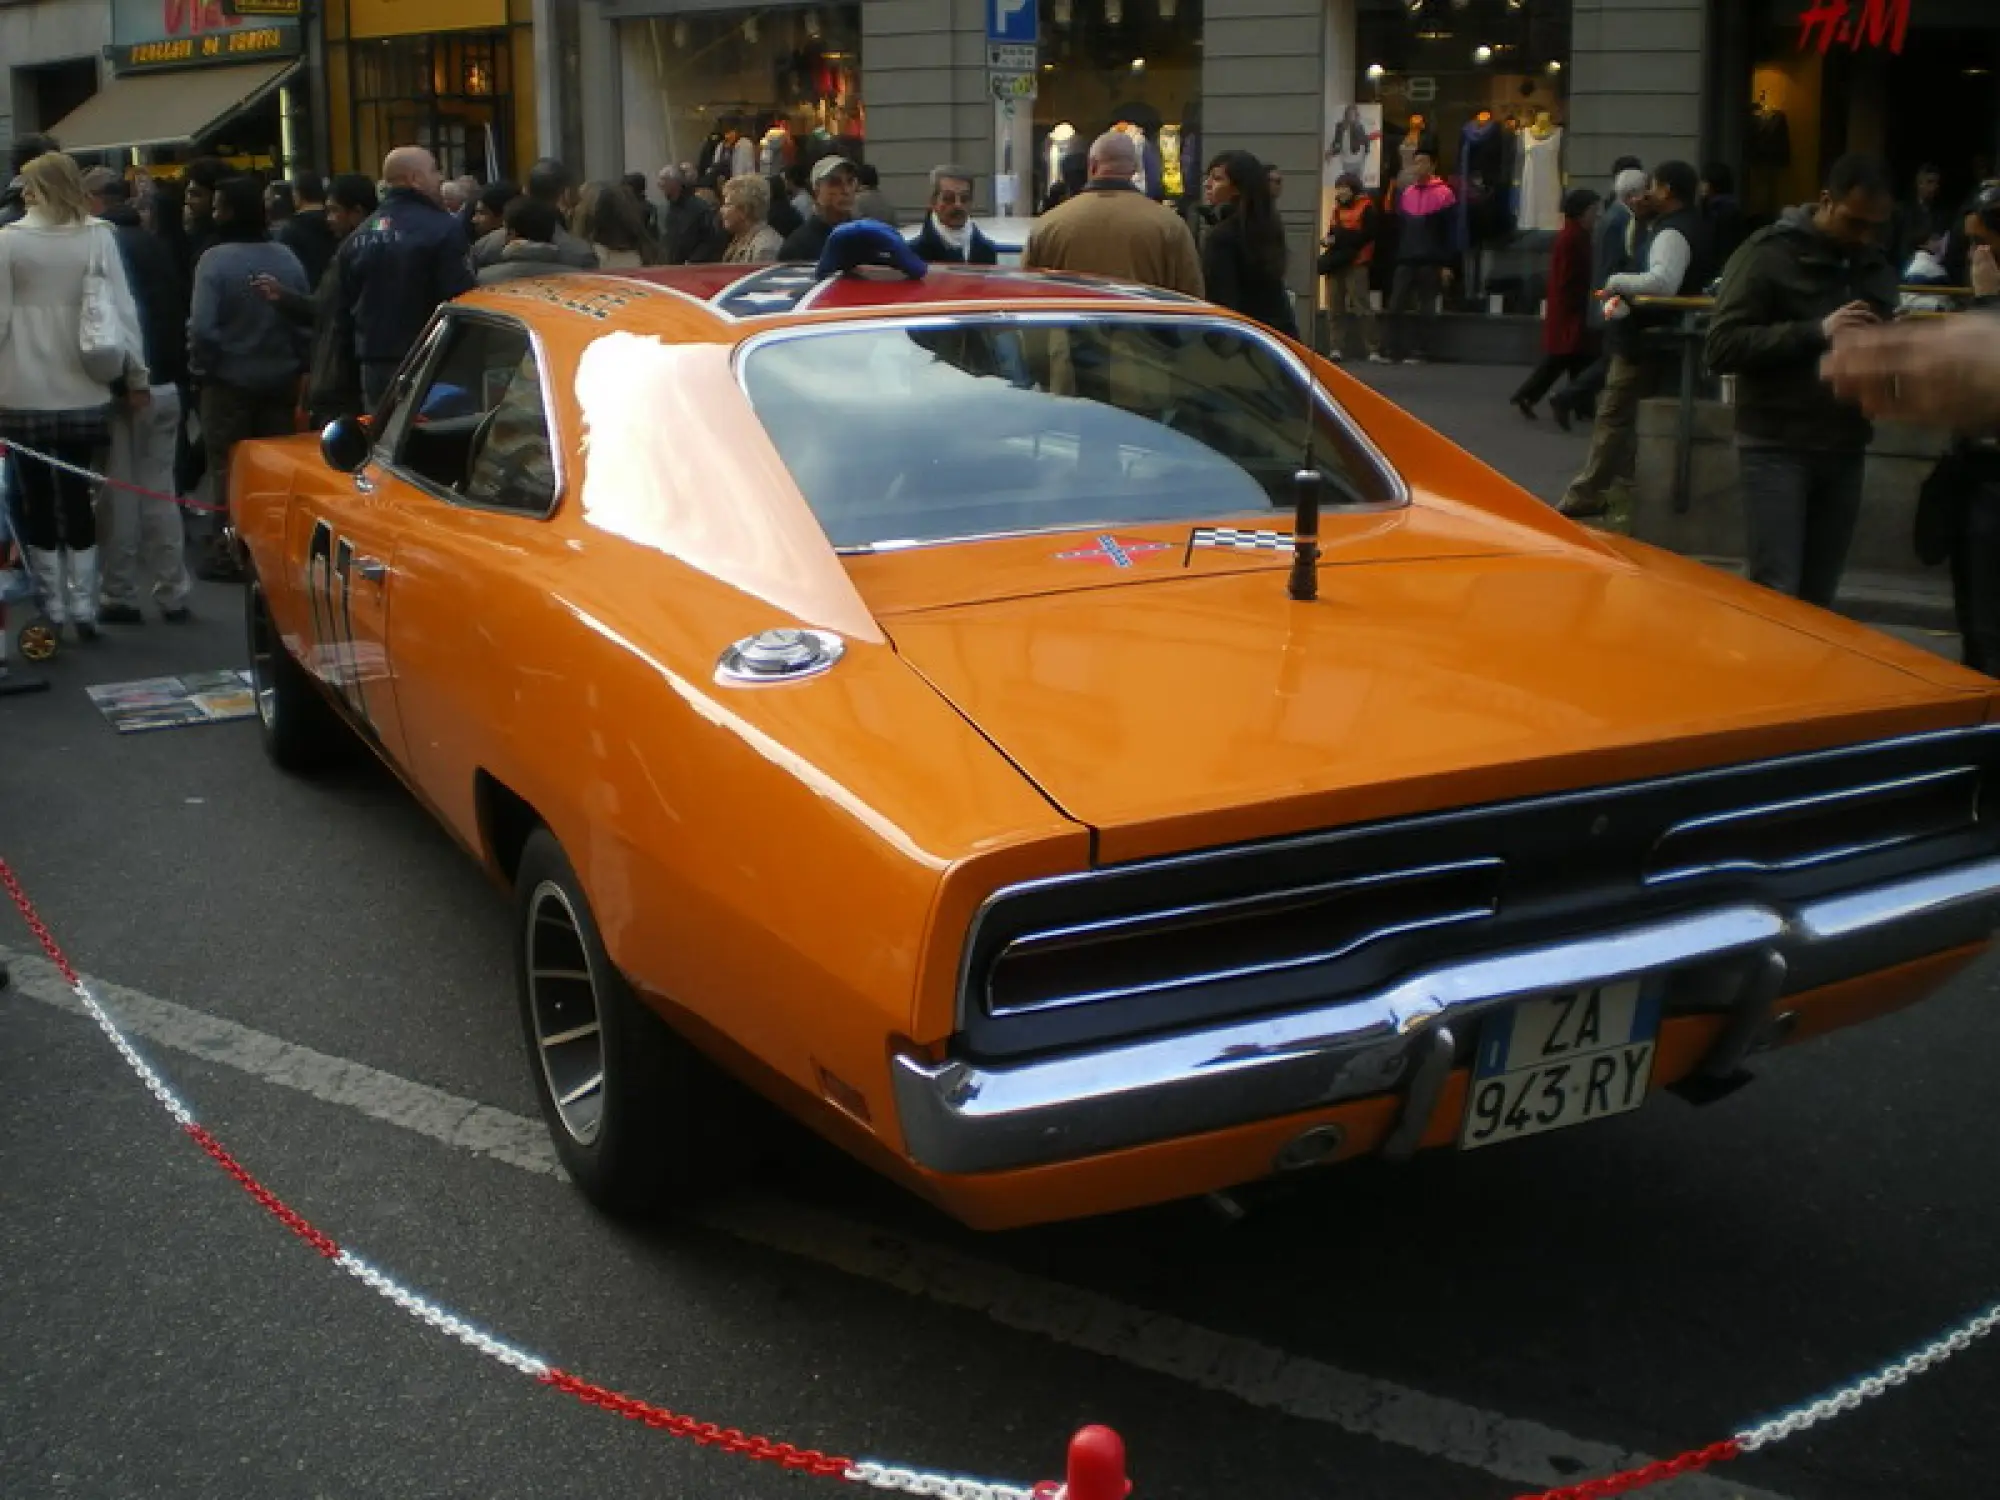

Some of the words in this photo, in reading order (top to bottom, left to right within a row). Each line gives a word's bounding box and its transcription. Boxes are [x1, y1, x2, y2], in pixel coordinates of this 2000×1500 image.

[1798, 0, 1911, 56] H&M
[1543, 990, 1600, 1055] ZA
[1473, 1066, 1570, 1138] 943
[1583, 1048, 1649, 1115] RY
